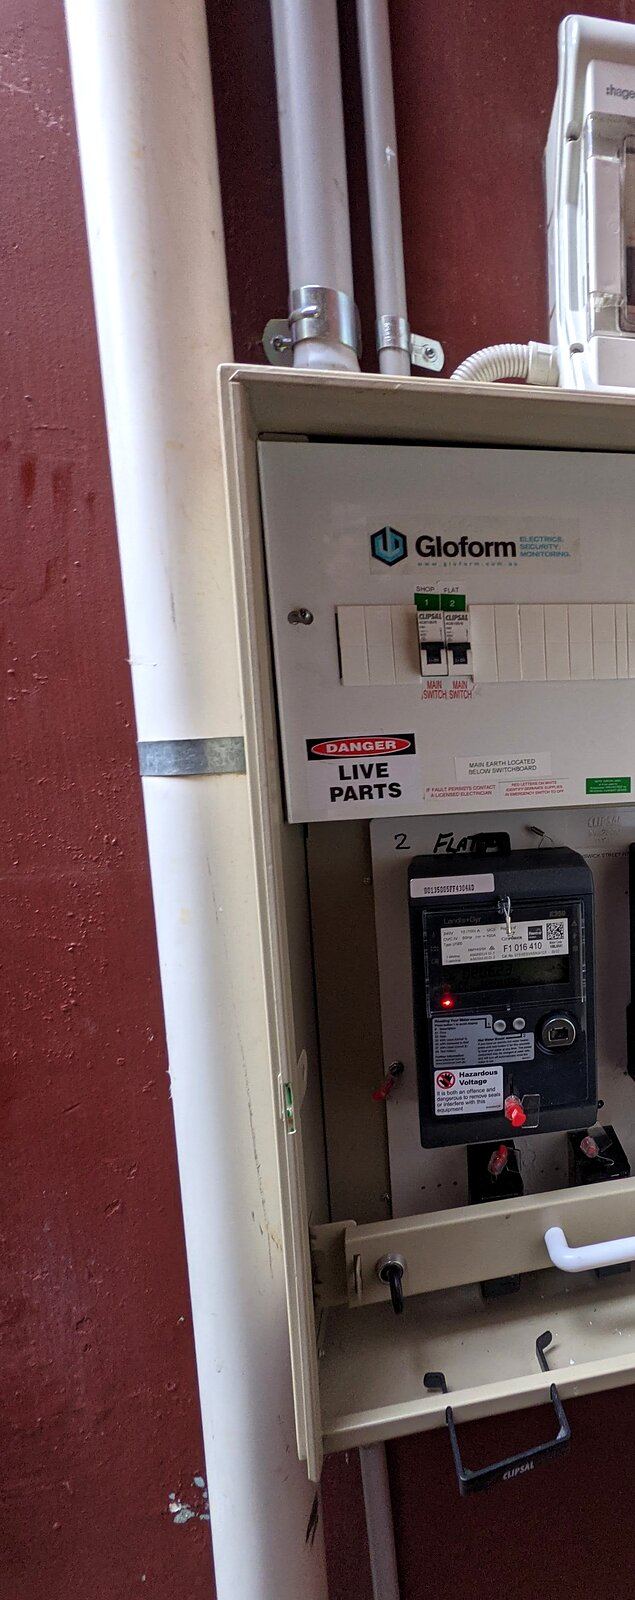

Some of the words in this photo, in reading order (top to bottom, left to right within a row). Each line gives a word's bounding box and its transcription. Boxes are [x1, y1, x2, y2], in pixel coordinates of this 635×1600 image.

[415, 535, 517, 558] Gloform
[416, 585, 435, 593] SHOP
[424, 598, 429, 606] 1
[449, 599, 455, 607] 2
[427, 681, 442, 689] MAIN
[452, 681, 467, 689] MAIN
[423, 690, 447, 700] SWITCH
[449, 690, 473, 700] SWITCH
[326, 740, 397, 754] DANGER
[469, 761, 485, 769] MAIN
[486, 760, 507, 768] EARTH
[507, 758, 536, 766] LOCATED
[339, 762, 389, 781] LIVE
[468, 767, 491, 775] BELOW
[491, 764, 537, 774] SWITCHBOARD
[329, 782, 402, 803] PARTS
[394, 832, 411, 850] 2
[503, 944, 512, 953] F1
[514, 943, 528, 952] 016
[528, 941, 543, 950] 410
[459, 1070, 498, 1078] Hazardous
[503, 1460, 535, 1480] CLIPSAL
